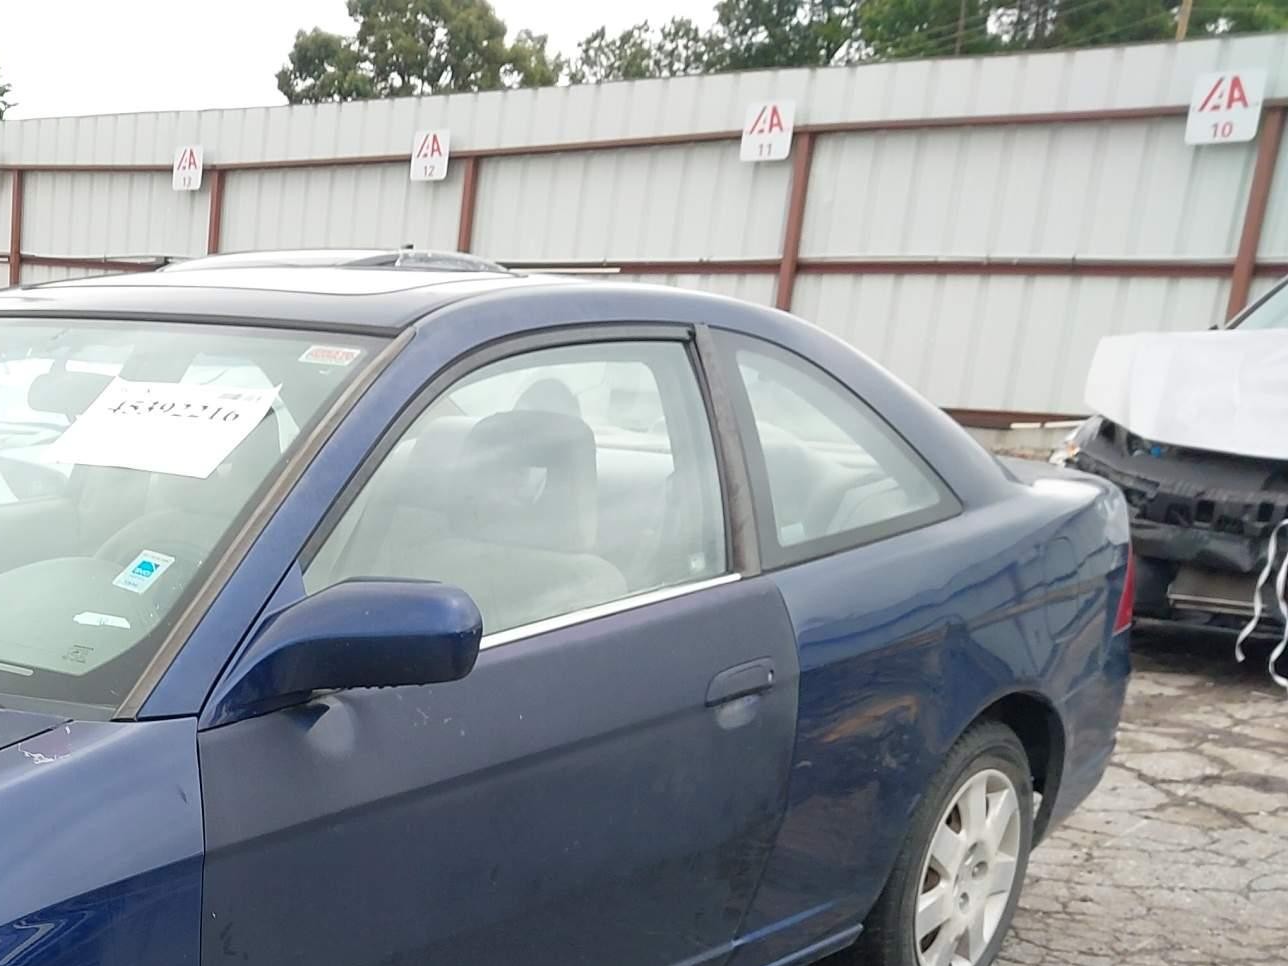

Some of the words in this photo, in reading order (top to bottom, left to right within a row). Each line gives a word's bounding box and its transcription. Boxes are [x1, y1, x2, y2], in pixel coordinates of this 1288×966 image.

[1211, 121, 1234, 139] 10
[758, 143, 772, 157] 11
[423, 165, 436, 177] 12
